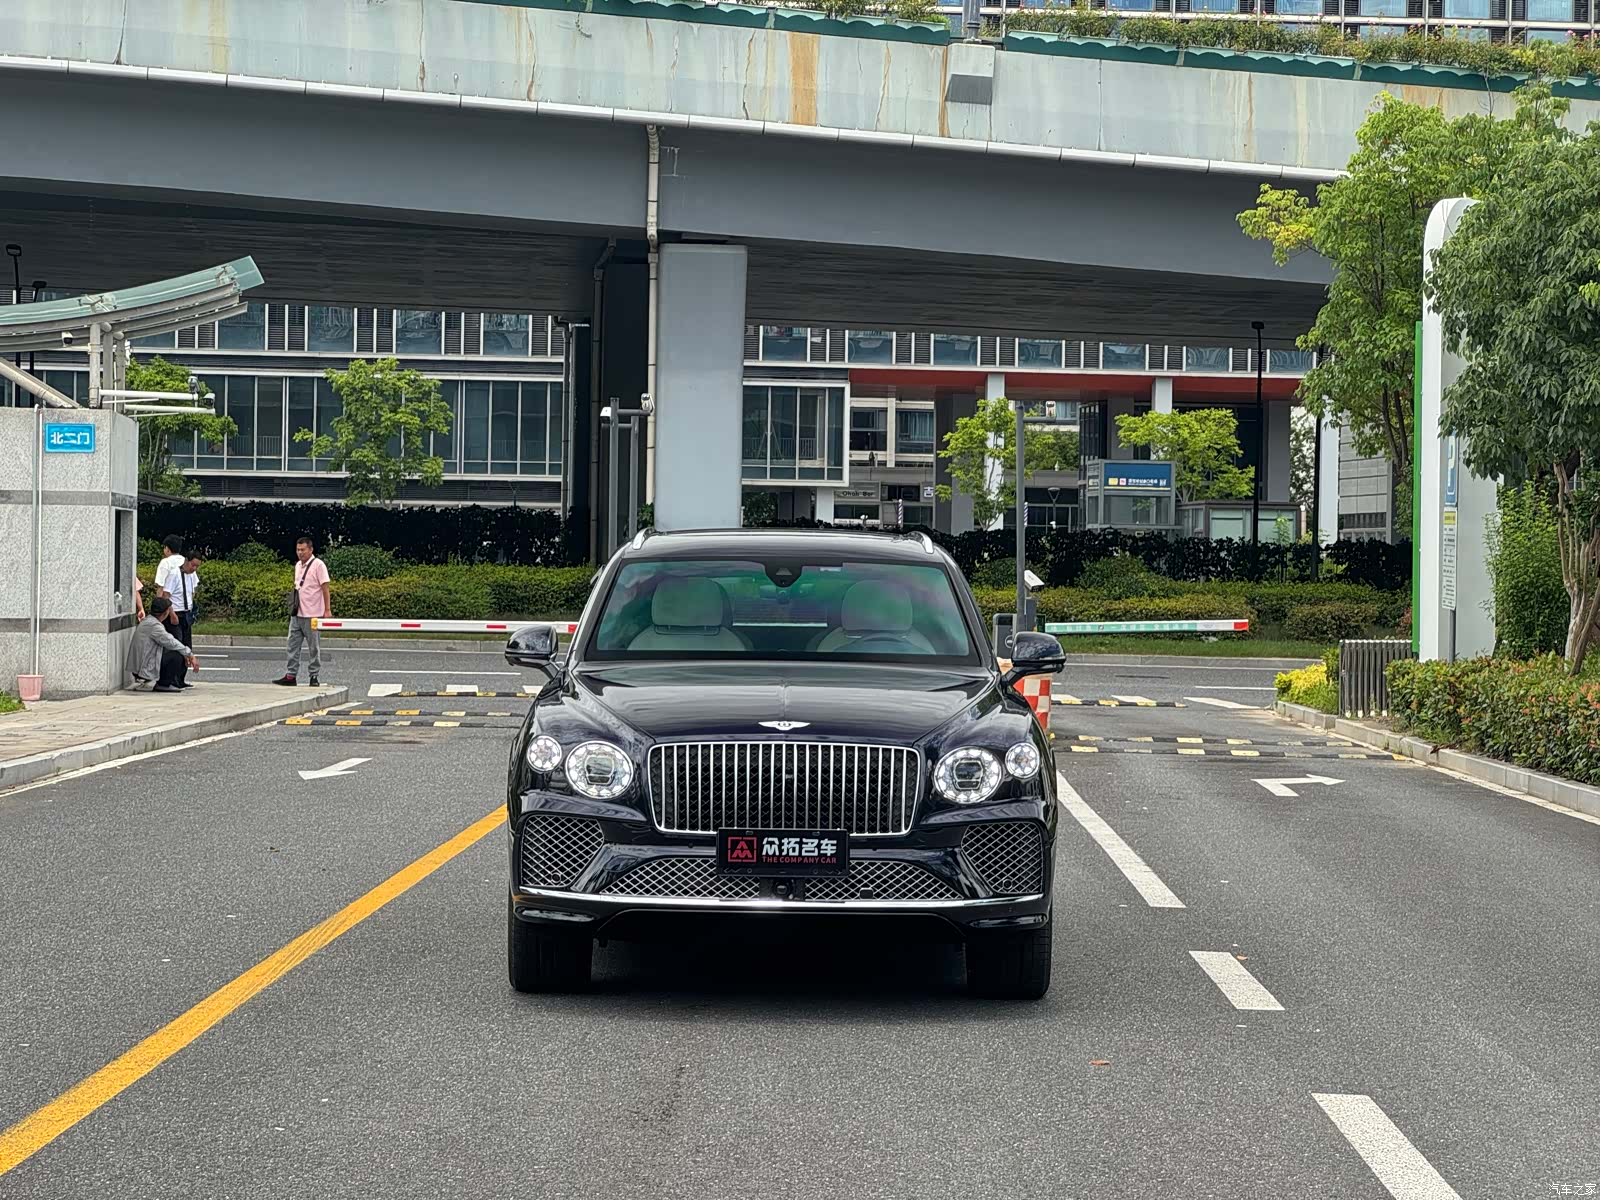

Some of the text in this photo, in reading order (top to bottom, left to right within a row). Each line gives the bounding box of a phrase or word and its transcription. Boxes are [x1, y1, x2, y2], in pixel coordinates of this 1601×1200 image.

[50, 431, 90, 445] 北二门
[761, 837, 838, 857] 众拓名车
[779, 856, 820, 864] COMPANY
